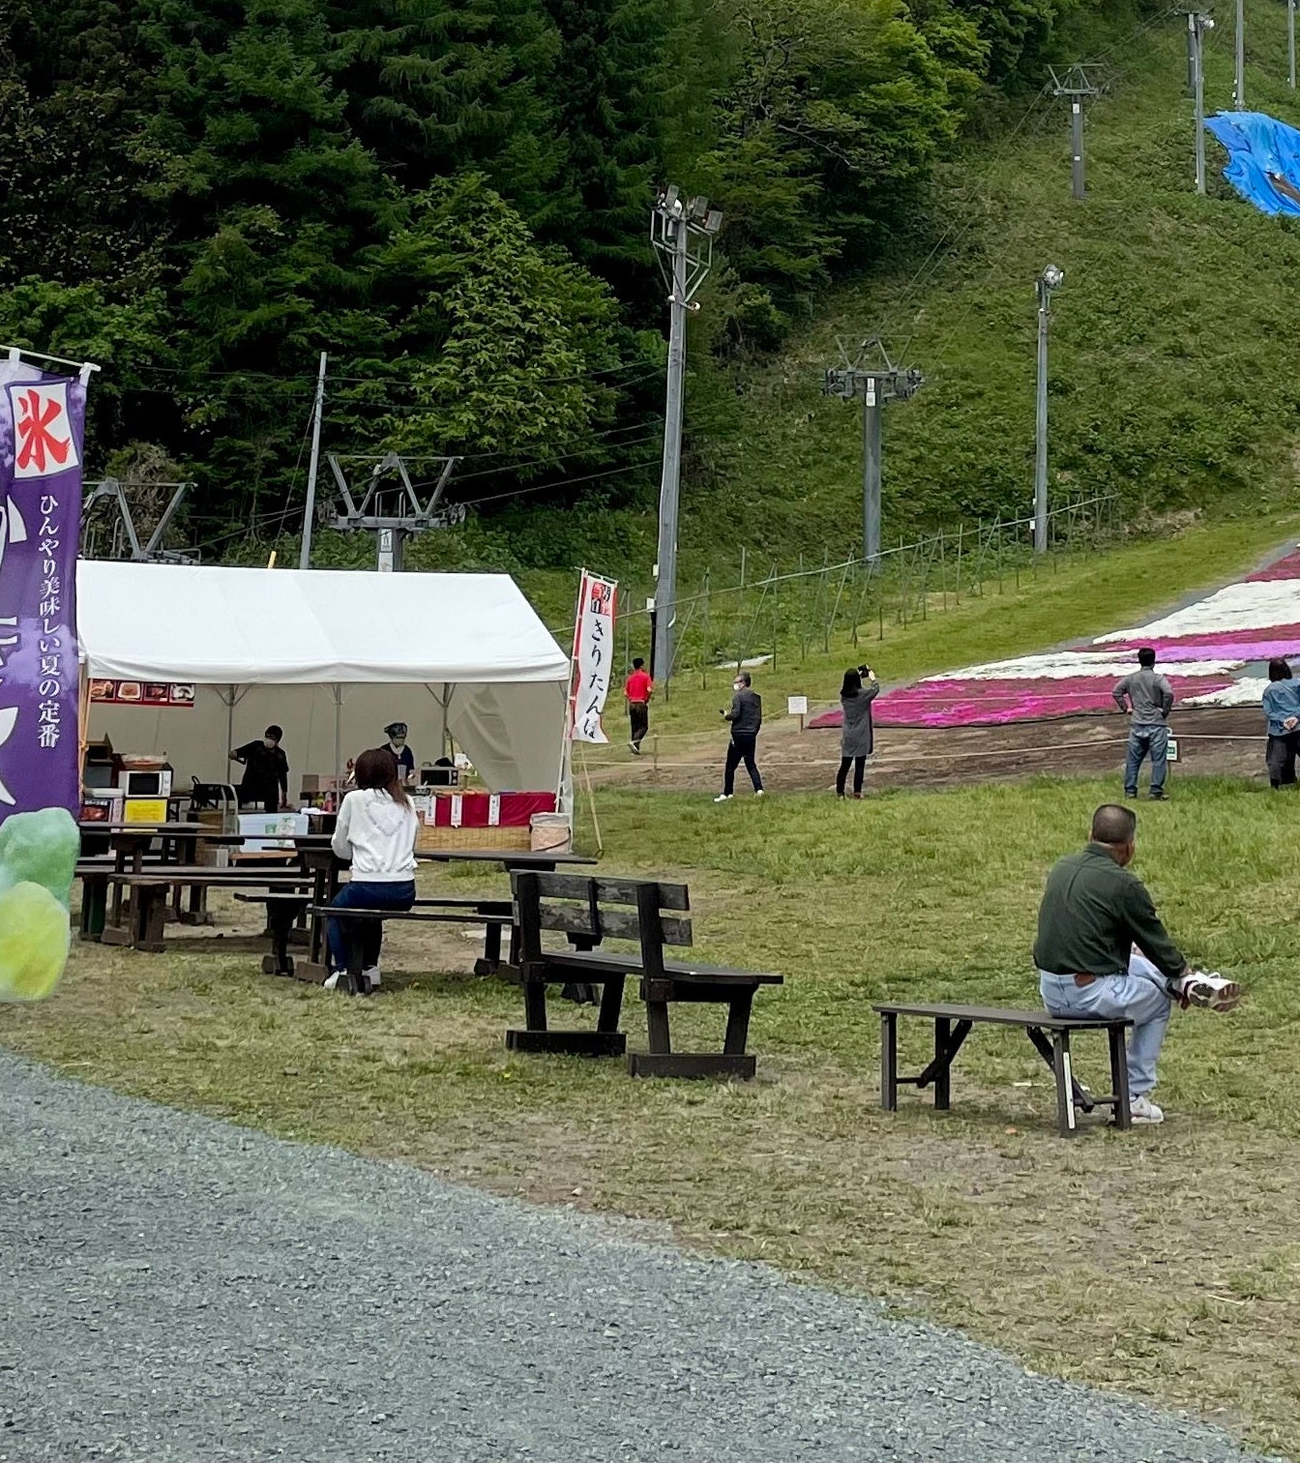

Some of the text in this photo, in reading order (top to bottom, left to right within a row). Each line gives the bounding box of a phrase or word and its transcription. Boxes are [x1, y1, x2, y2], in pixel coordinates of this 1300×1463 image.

[16, 388, 71, 473] 氷
[37, 495, 61, 748] ひんやり美味しい夏の定番
